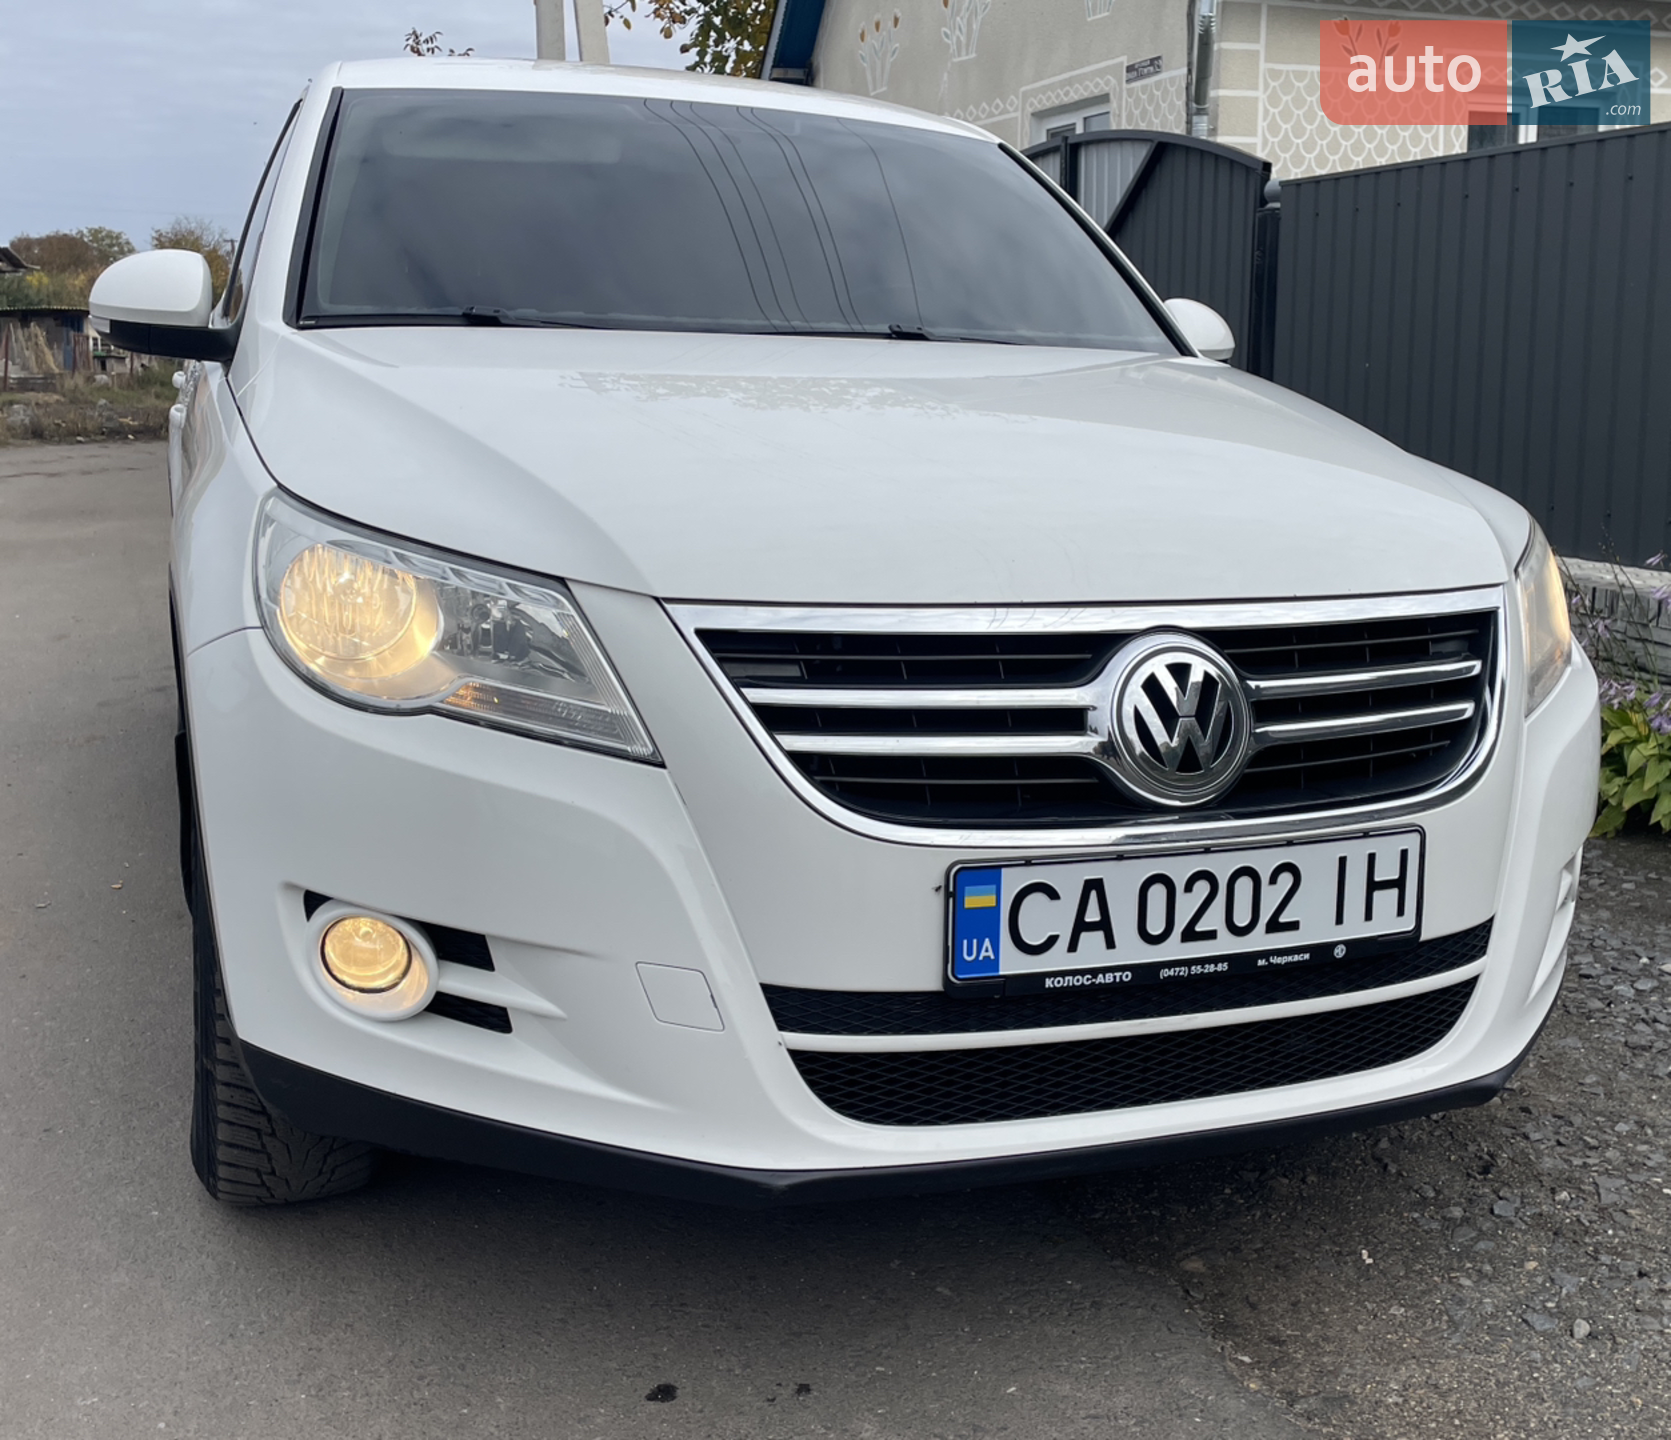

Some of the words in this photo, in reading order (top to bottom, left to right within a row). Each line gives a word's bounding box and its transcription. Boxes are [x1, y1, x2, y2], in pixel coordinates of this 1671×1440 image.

[1007, 876, 1117, 956] CA
[1136, 860, 1303, 946] 0202
[1334, 847, 1410, 926] IH
[961, 938, 996, 963] UA
[1044, 971, 1133, 989] КОЛОС-АВТО
[1159, 965, 1189, 980] (0472)
[1190, 962, 1229, 976] 55-28-85
[1269, 952, 1311, 966] Черкаси
